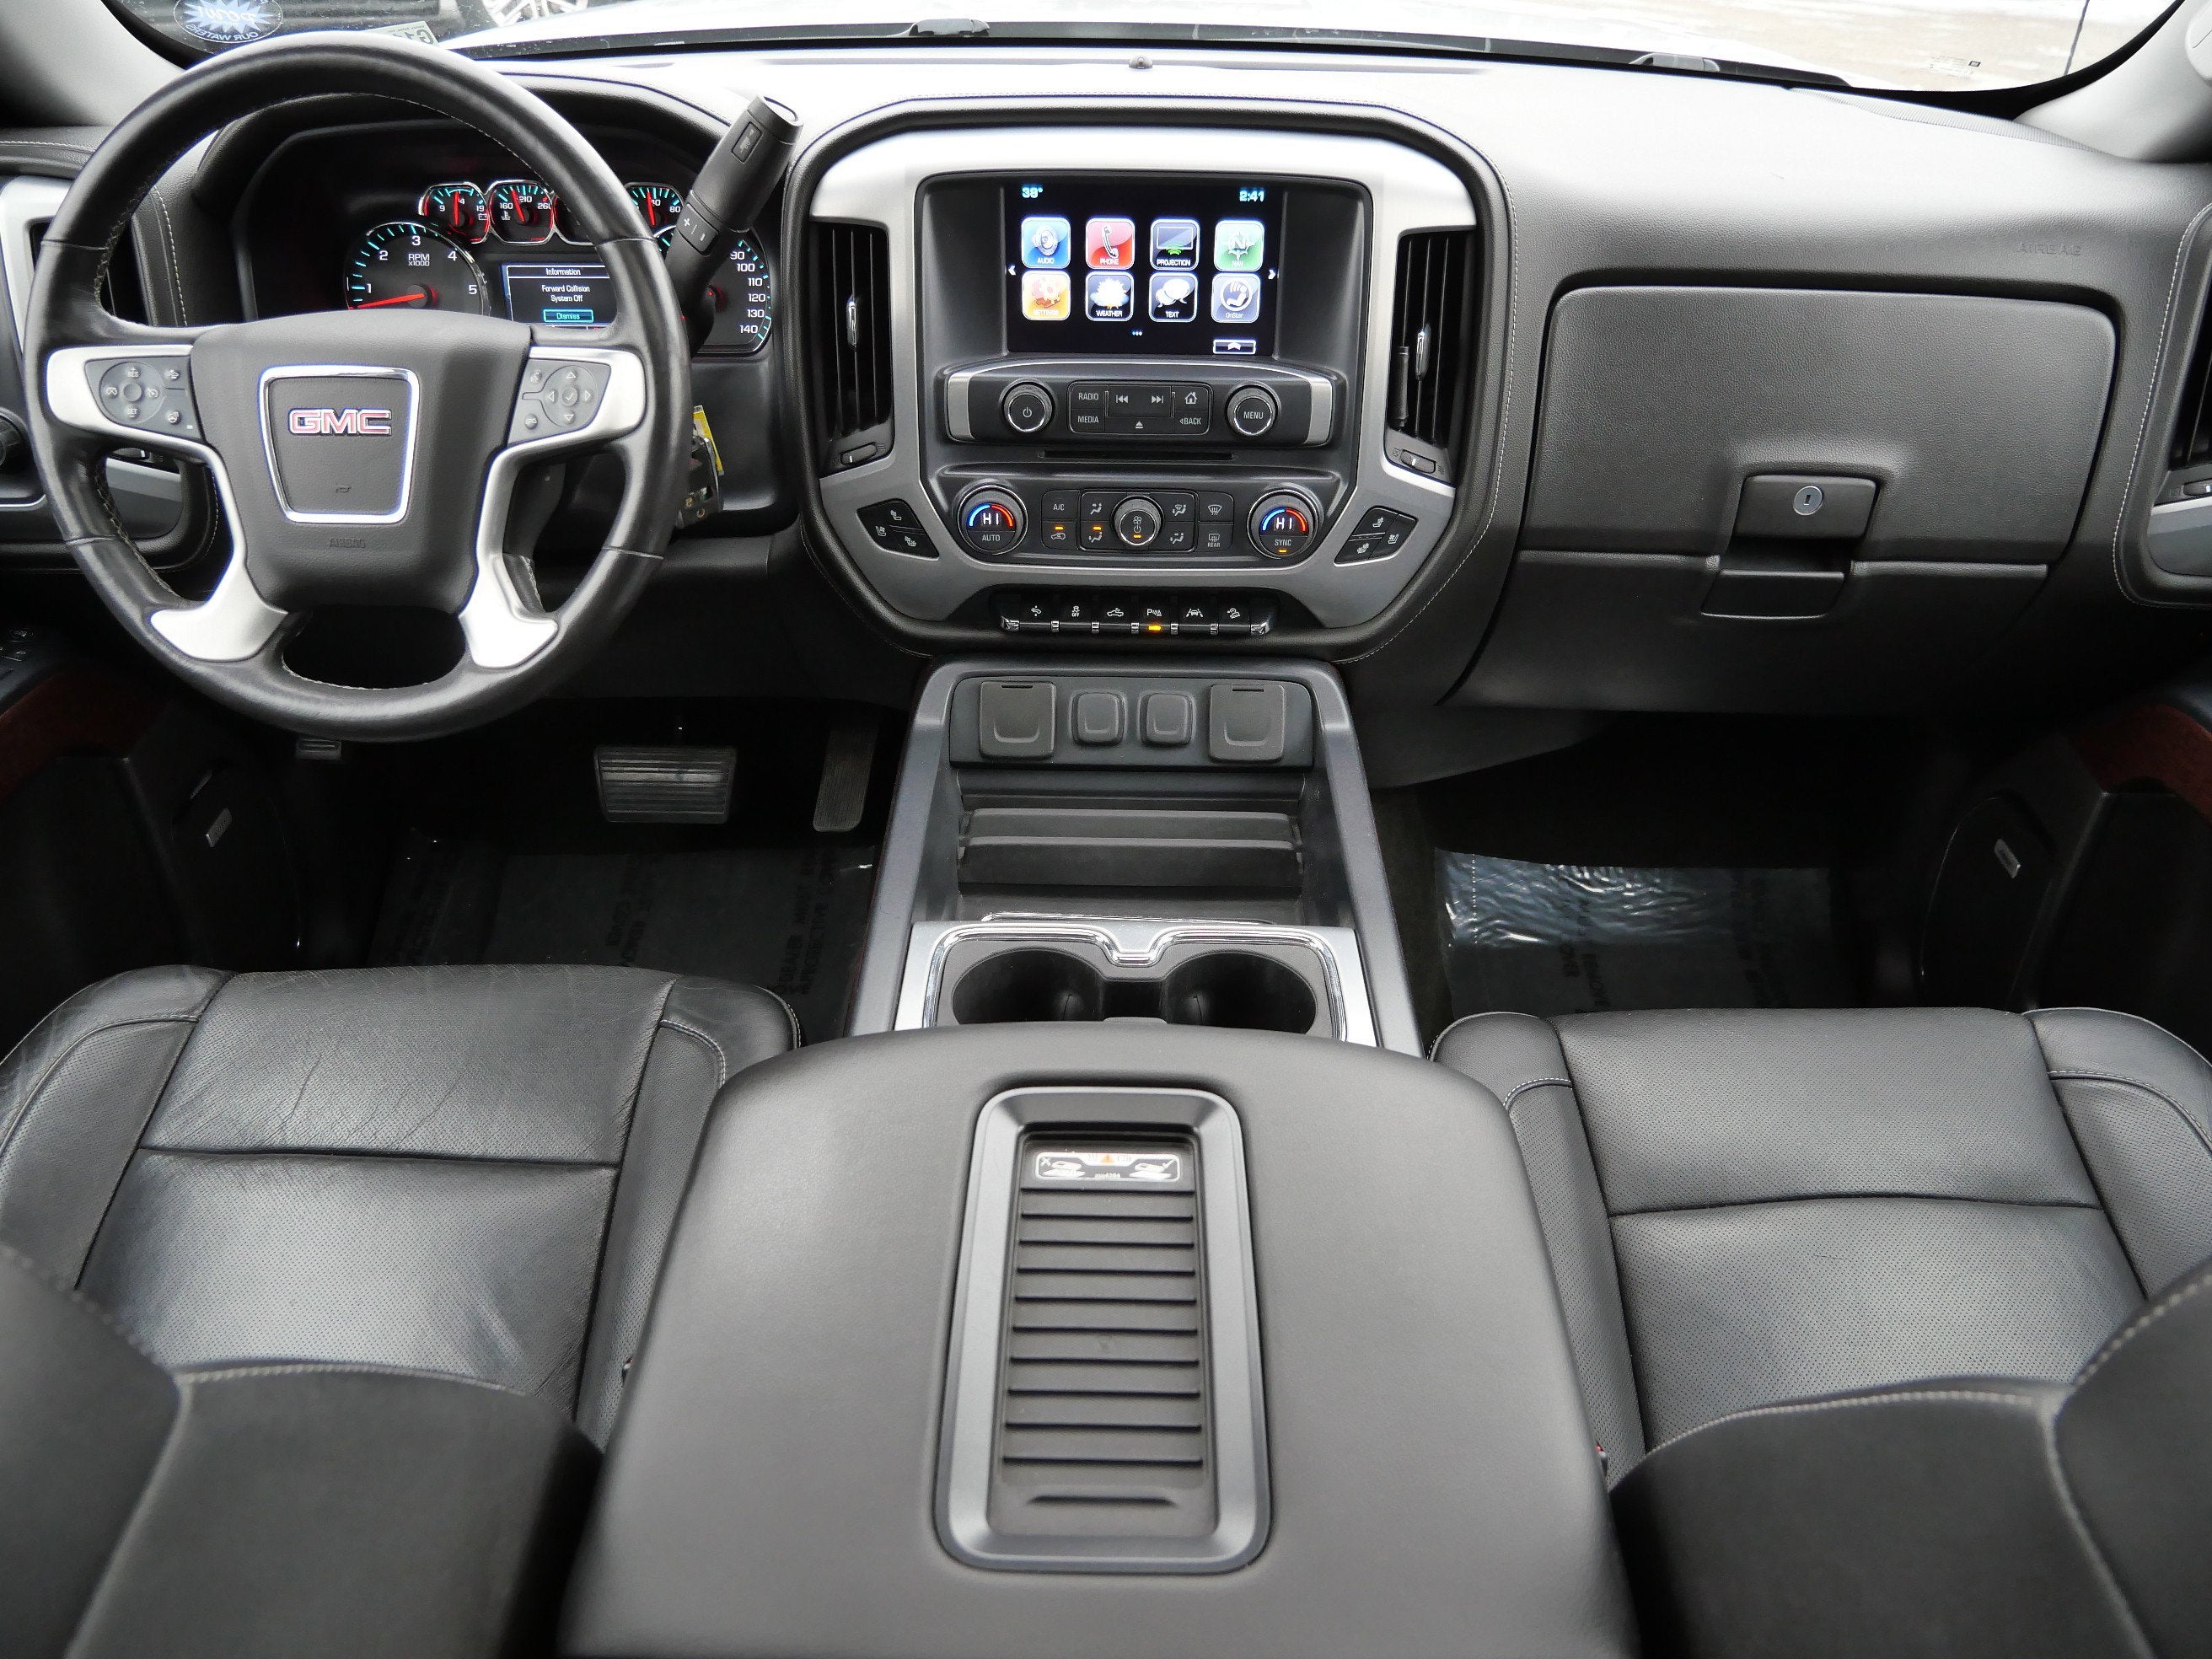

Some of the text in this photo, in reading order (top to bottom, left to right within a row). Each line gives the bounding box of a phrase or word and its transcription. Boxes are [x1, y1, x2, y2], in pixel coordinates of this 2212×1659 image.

[1239, 191, 1264, 201] 2:41
[411, 235, 421, 245] 3
[2017, 242, 2082, 256] AIRBAG
[379, 250, 389, 260] 2
[448, 251, 457, 260] 4
[730, 251, 745, 260] 90
[368, 283, 372, 293] 1
[469, 285, 478, 294] 5
[550, 295, 573, 303] System
[740, 325, 759, 333] 140
[1078, 392, 1099, 400] RADIO
[288, 408, 392, 435] GMC
[983, 513, 999, 525] HI
[1275, 517, 1292, 530] HI
[330, 538, 366, 548] AIRBAG
